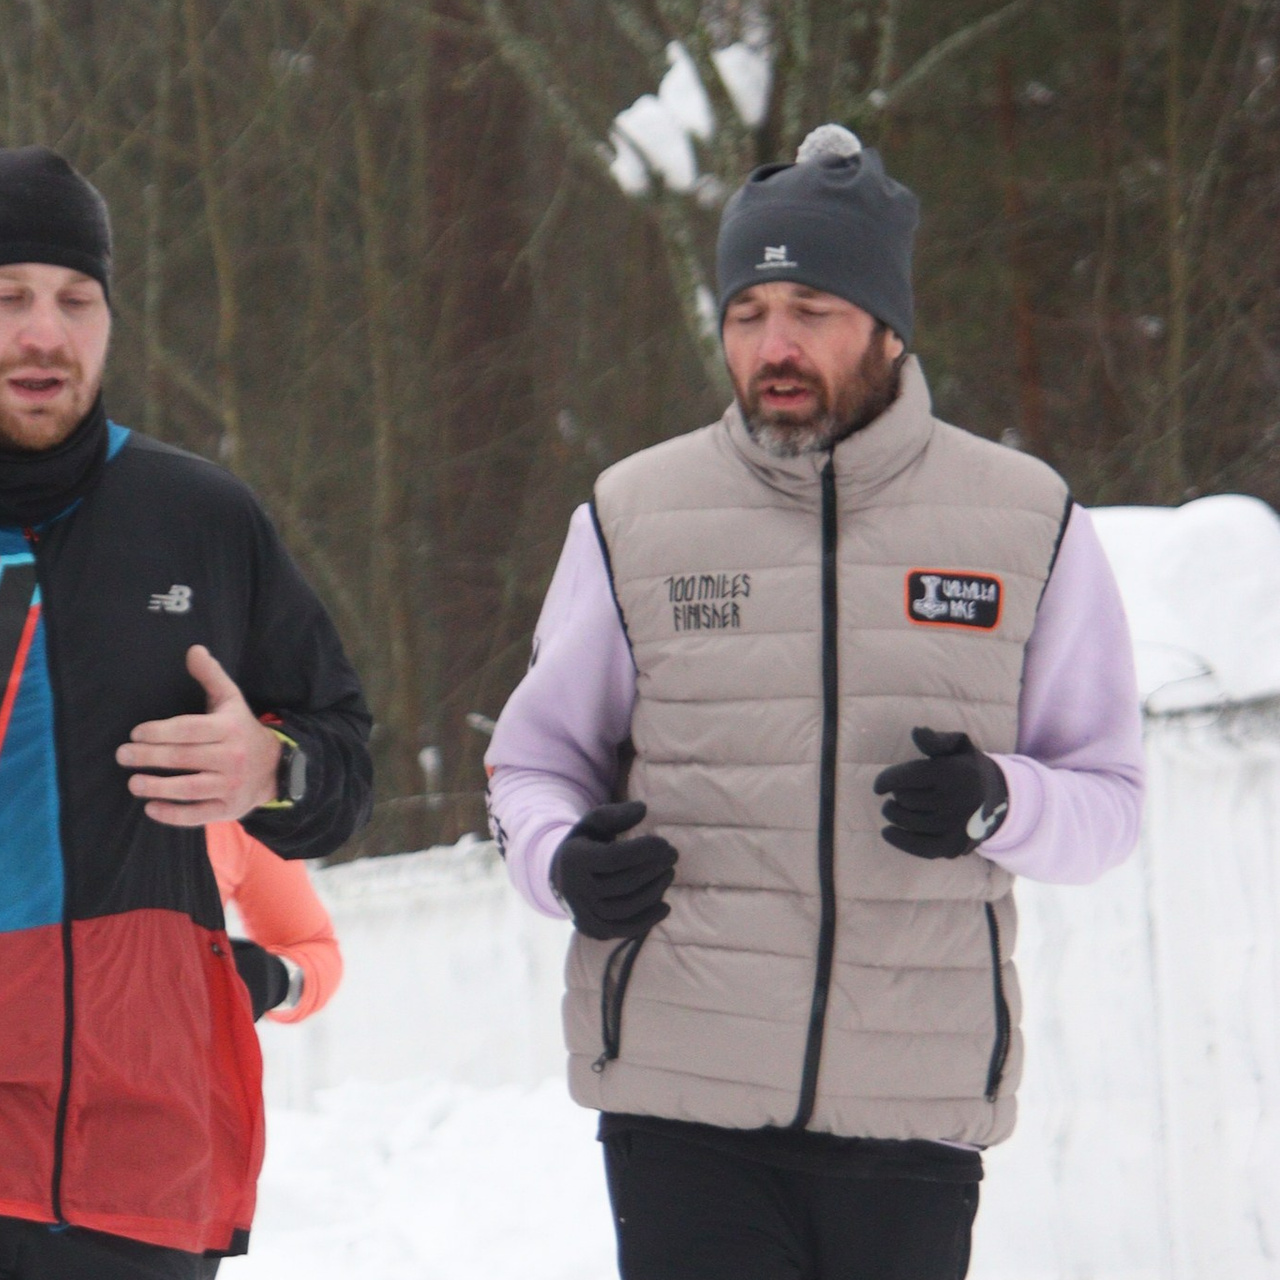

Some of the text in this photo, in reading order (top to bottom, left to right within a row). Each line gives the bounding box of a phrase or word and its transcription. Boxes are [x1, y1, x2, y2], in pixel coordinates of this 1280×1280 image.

[664, 573, 750, 601] 100 MILES
[673, 602, 740, 631] FINISHER
